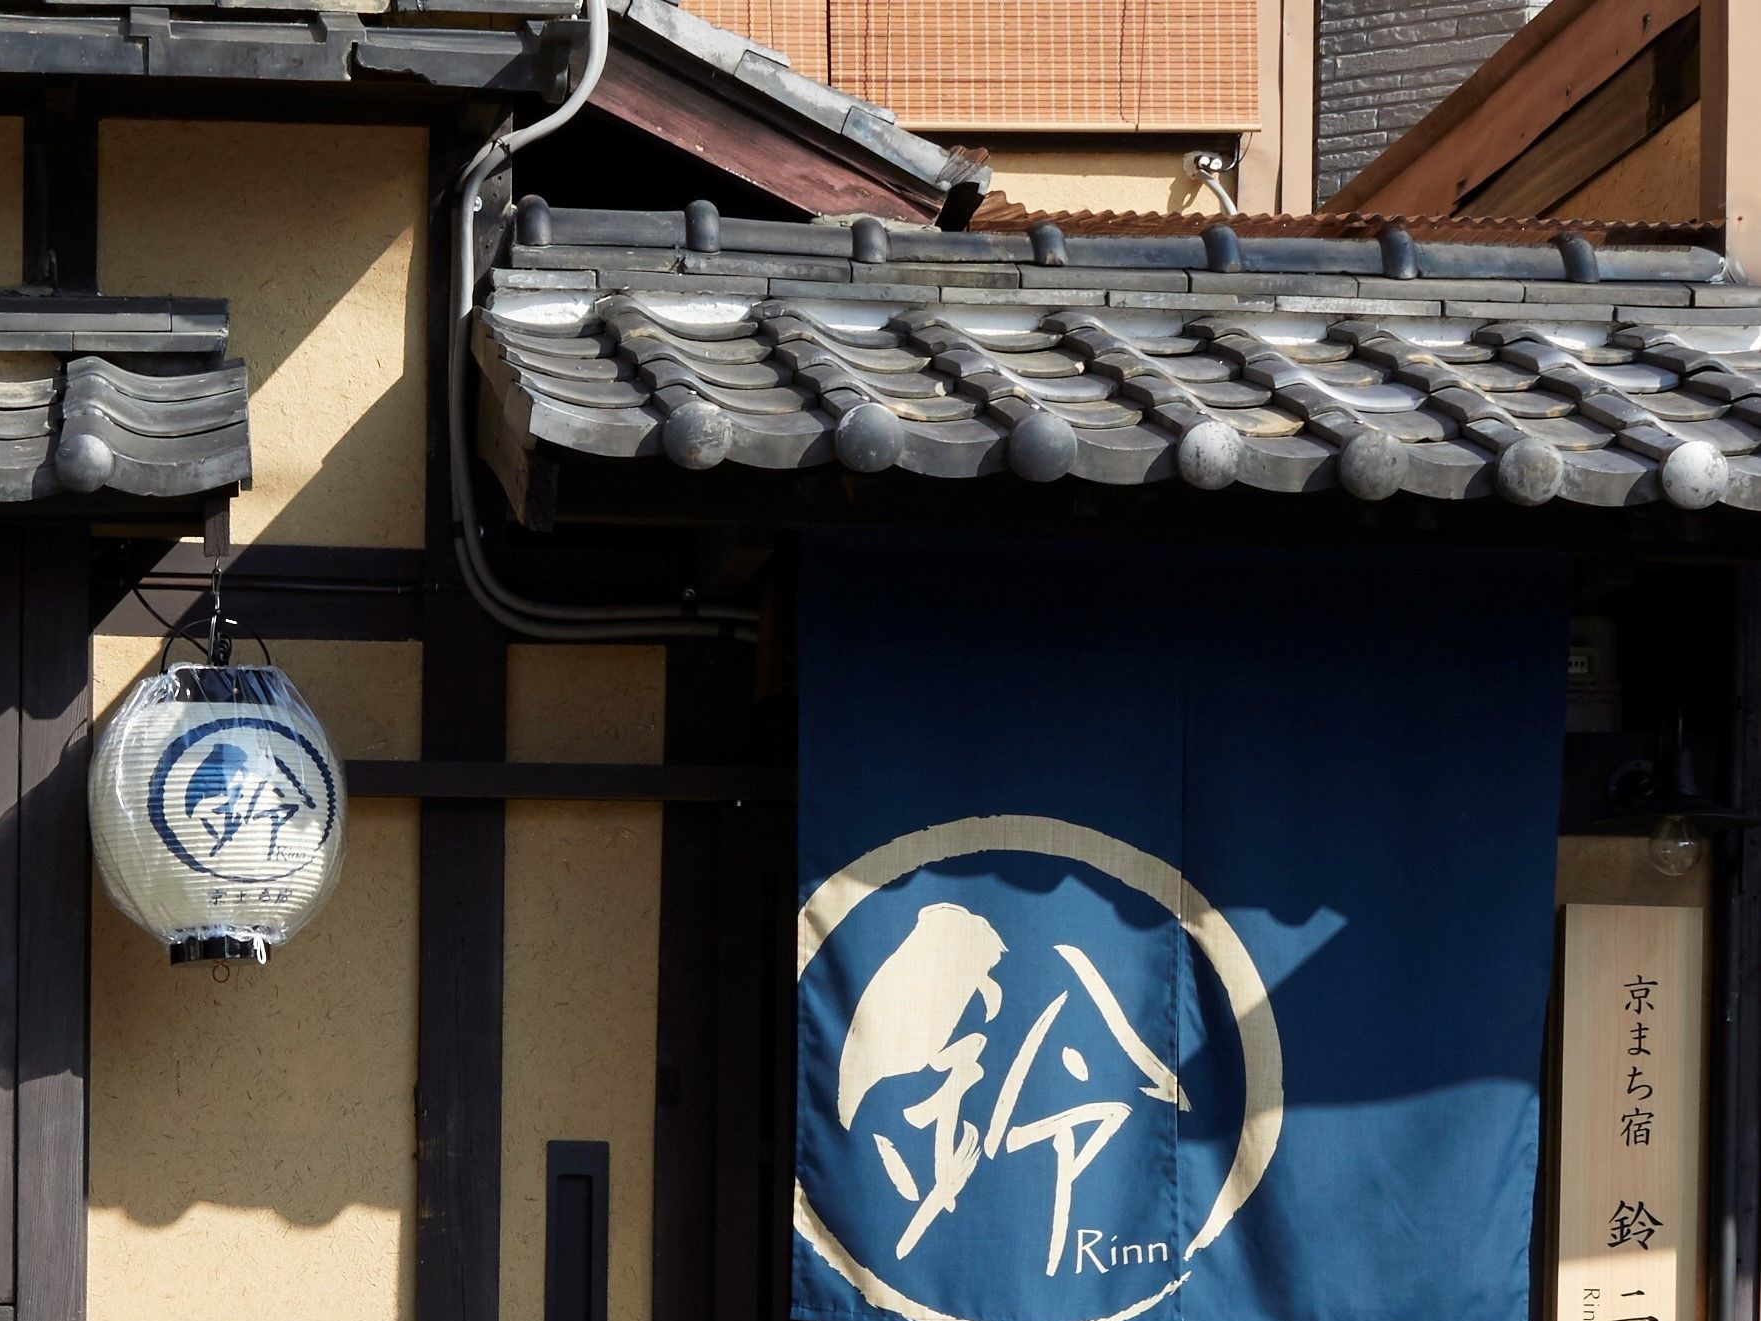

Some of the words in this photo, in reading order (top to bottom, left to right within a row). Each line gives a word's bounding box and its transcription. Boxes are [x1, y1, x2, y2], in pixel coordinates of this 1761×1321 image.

[1620, 974, 1659, 1147] 京まち宿
[1607, 1199, 1664, 1251] 鈴
[1076, 1229, 1169, 1275] Rinn
